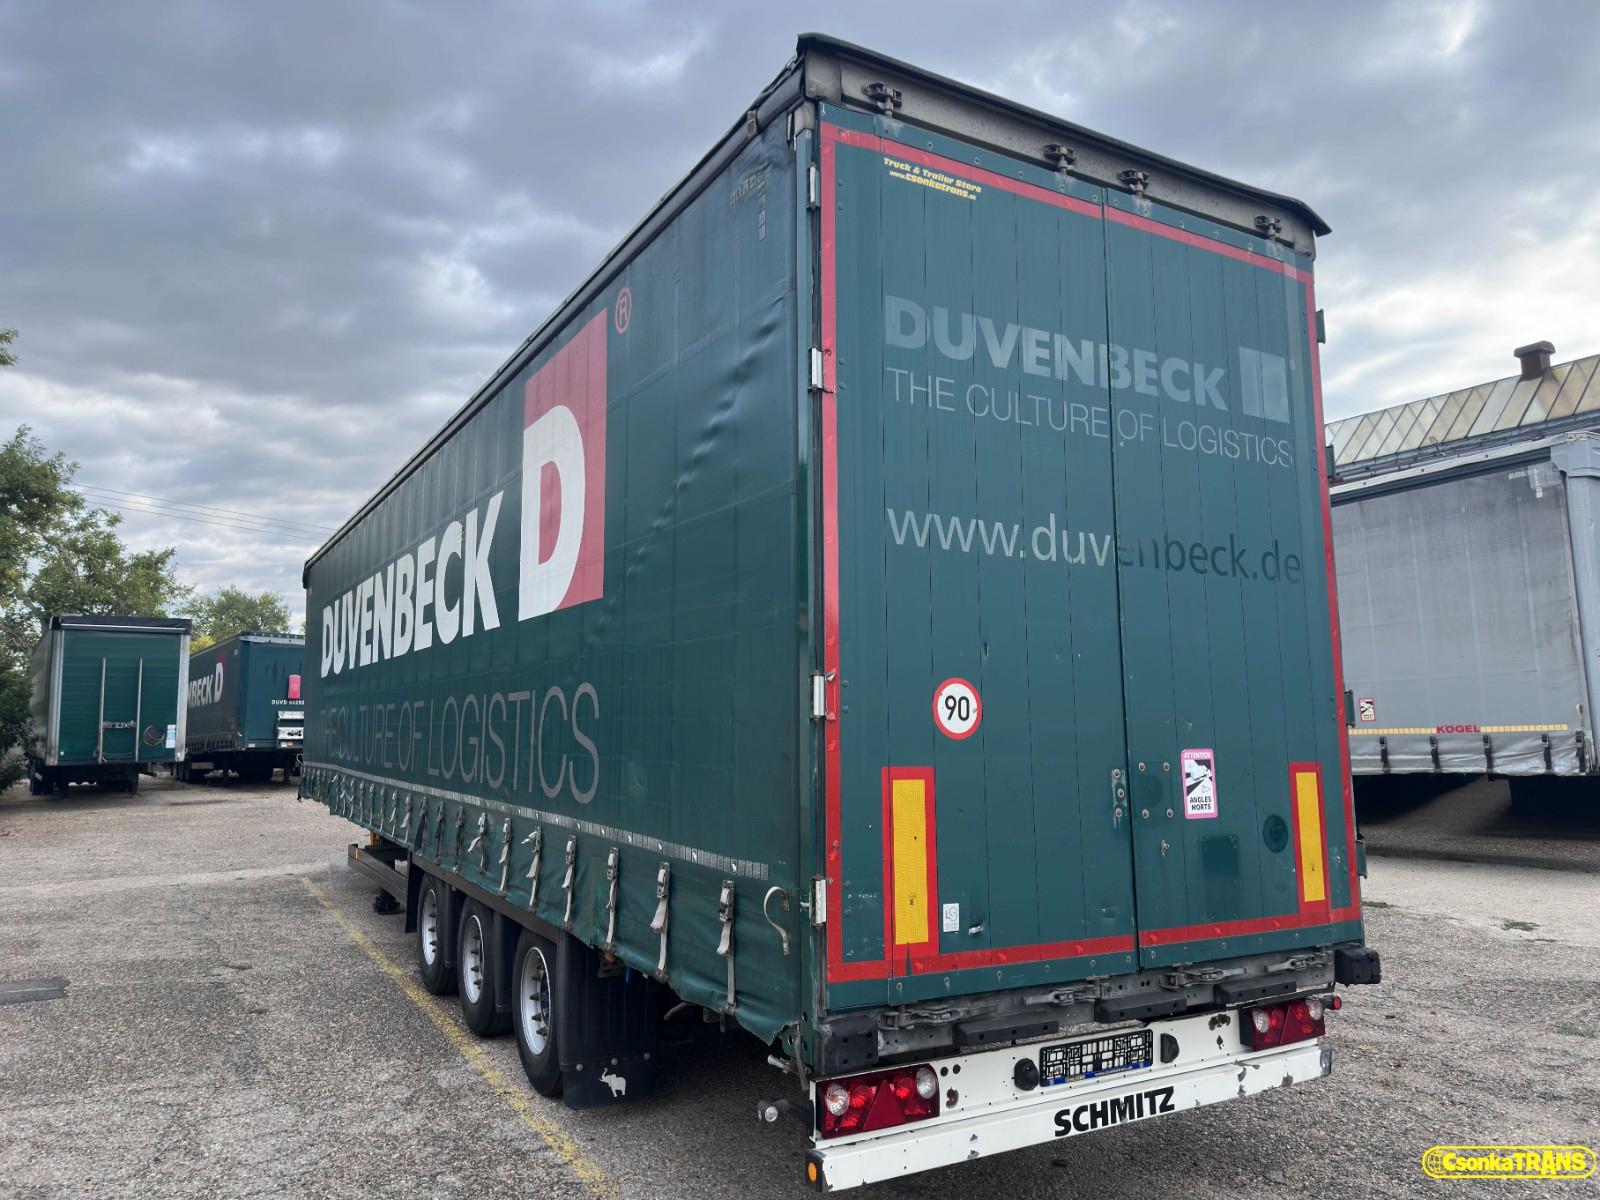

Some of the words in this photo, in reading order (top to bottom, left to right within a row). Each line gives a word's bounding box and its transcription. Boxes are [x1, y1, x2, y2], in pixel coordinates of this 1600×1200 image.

[884, 295, 1228, 411] DUVENBECK
[887, 367, 956, 411] THE
[966, 383, 1109, 439] CULTURE
[1119, 408, 1153, 441] OF
[1163, 420, 1293, 467] LOGISTICS
[320, 490, 504, 679] DUVENBECK
[887, 507, 1301, 584] www.duvenbeck.de
[398, 700, 425, 773] OF
[427, 682, 600, 804] LOGISTICS
[945, 695, 970, 721] 90
[1189, 796, 1212, 804] ANGLES
[1054, 1086, 1175, 1138] SCHMITZ
